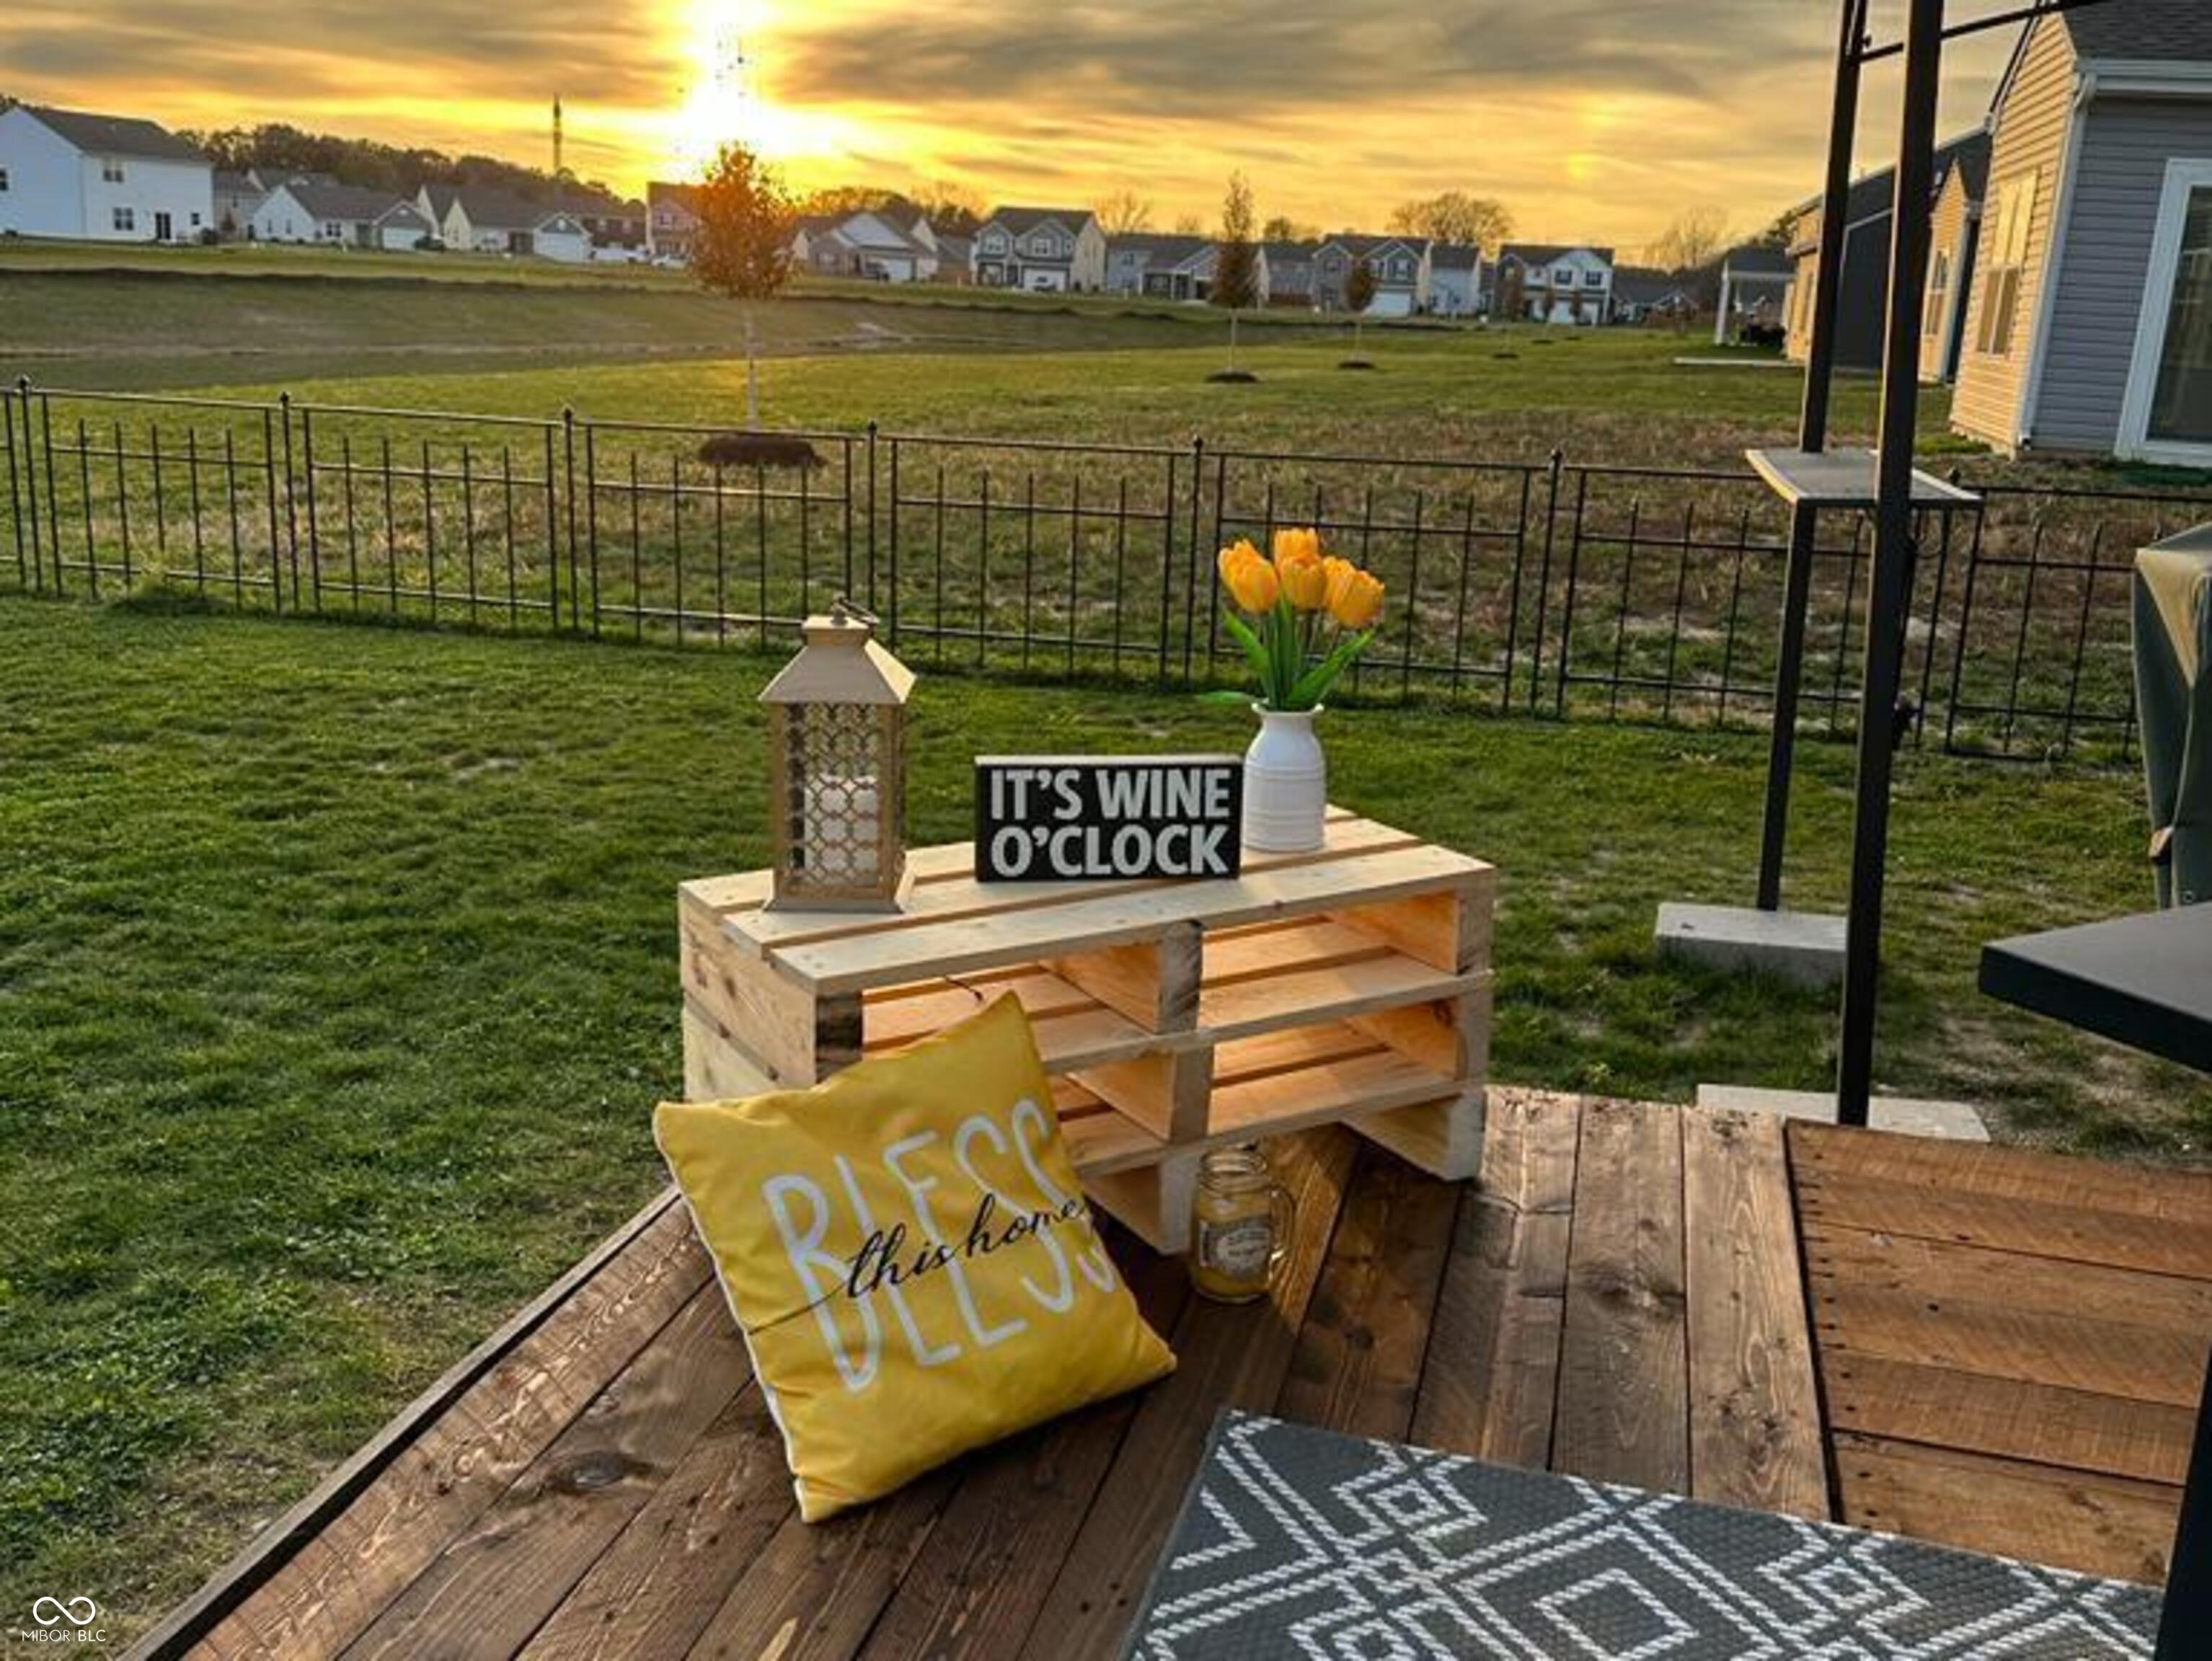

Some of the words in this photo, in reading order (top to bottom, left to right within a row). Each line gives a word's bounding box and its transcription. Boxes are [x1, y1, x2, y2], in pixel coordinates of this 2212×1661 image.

[991, 769, 1083, 820] IT'S
[1094, 769, 1230, 820] WINE
[991, 823, 1229, 877] O'CLOCK
[761, 1098, 1117, 1393] BLESS
[845, 1222, 953, 1298] this
[965, 1192, 1085, 1258] home
